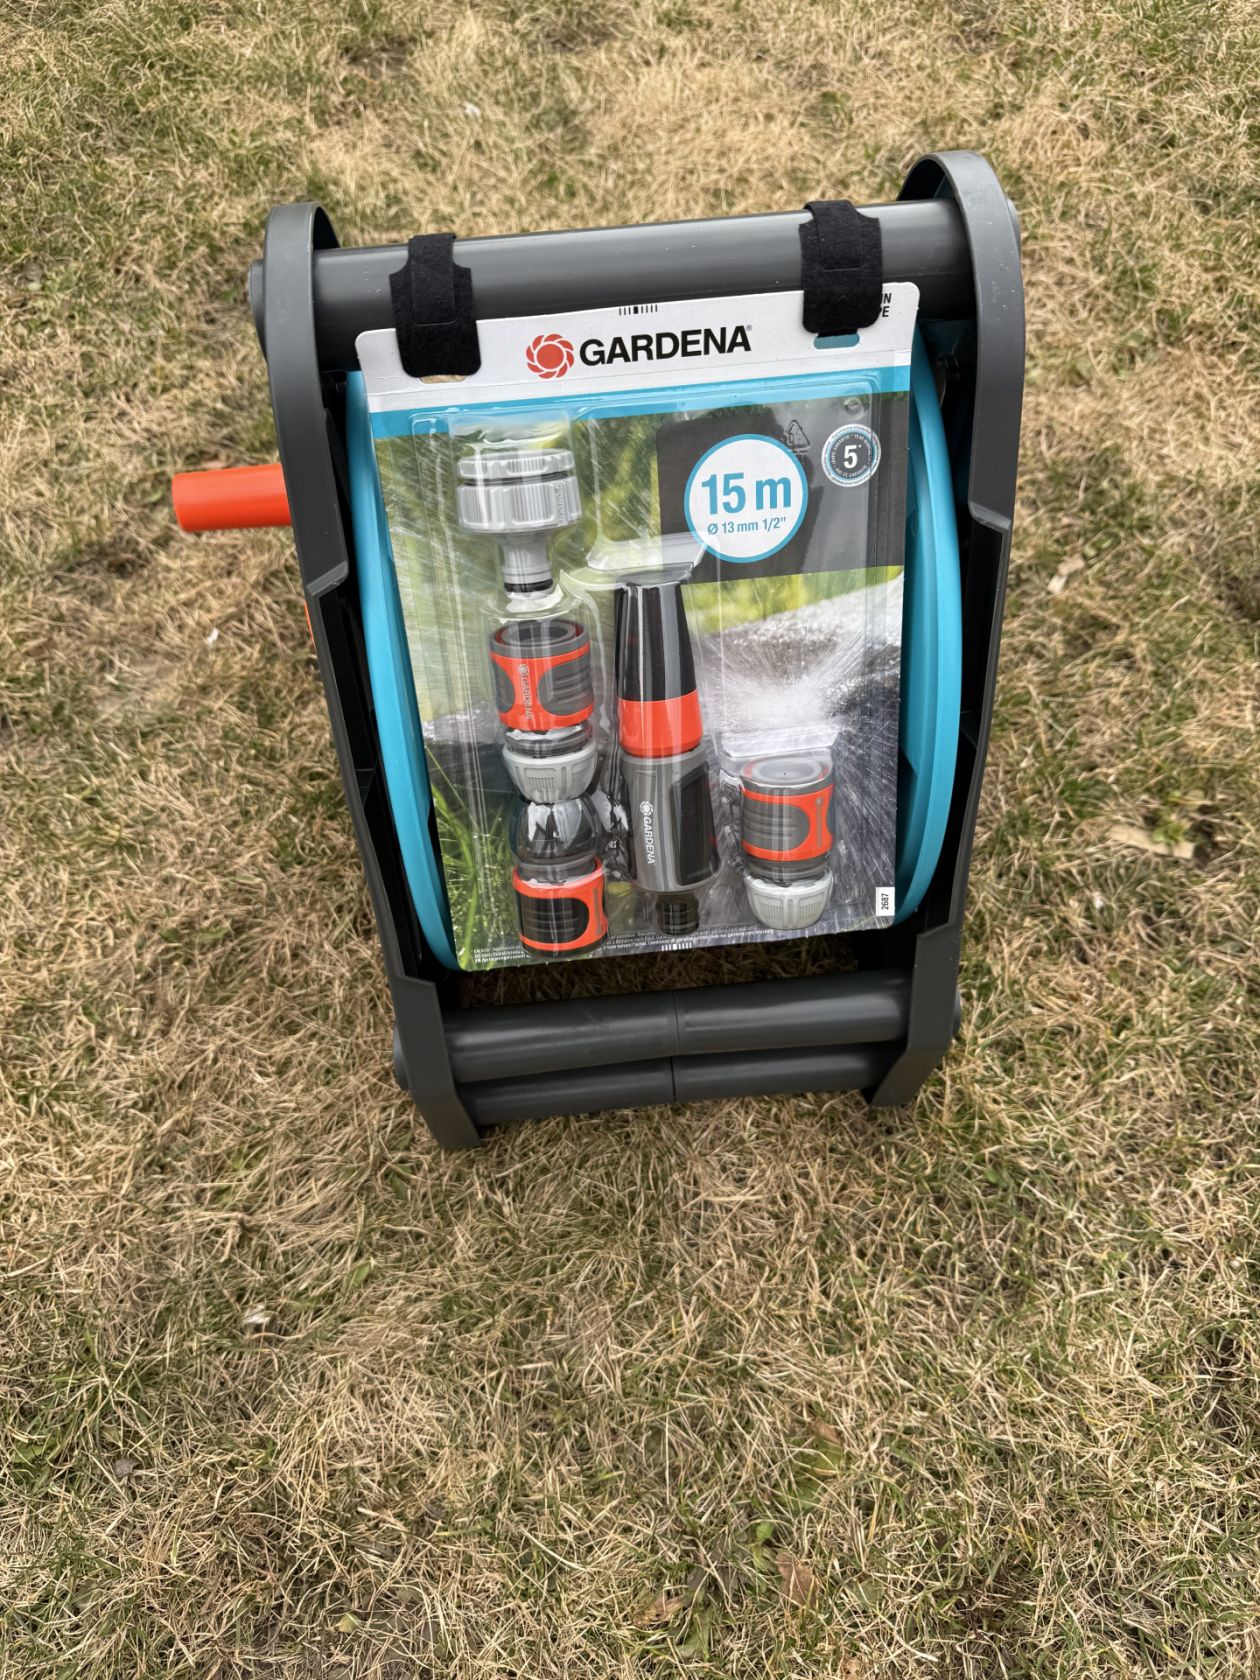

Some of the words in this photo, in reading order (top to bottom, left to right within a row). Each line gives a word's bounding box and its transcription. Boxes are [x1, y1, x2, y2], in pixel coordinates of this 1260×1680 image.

[701, 472, 746, 515] 15
[755, 477, 792, 511] m
[721, 521, 735, 533] 13
[737, 521, 759, 533] mm
[643, 816, 656, 865] GARDENA
[880, 892, 889, 911] 2687
